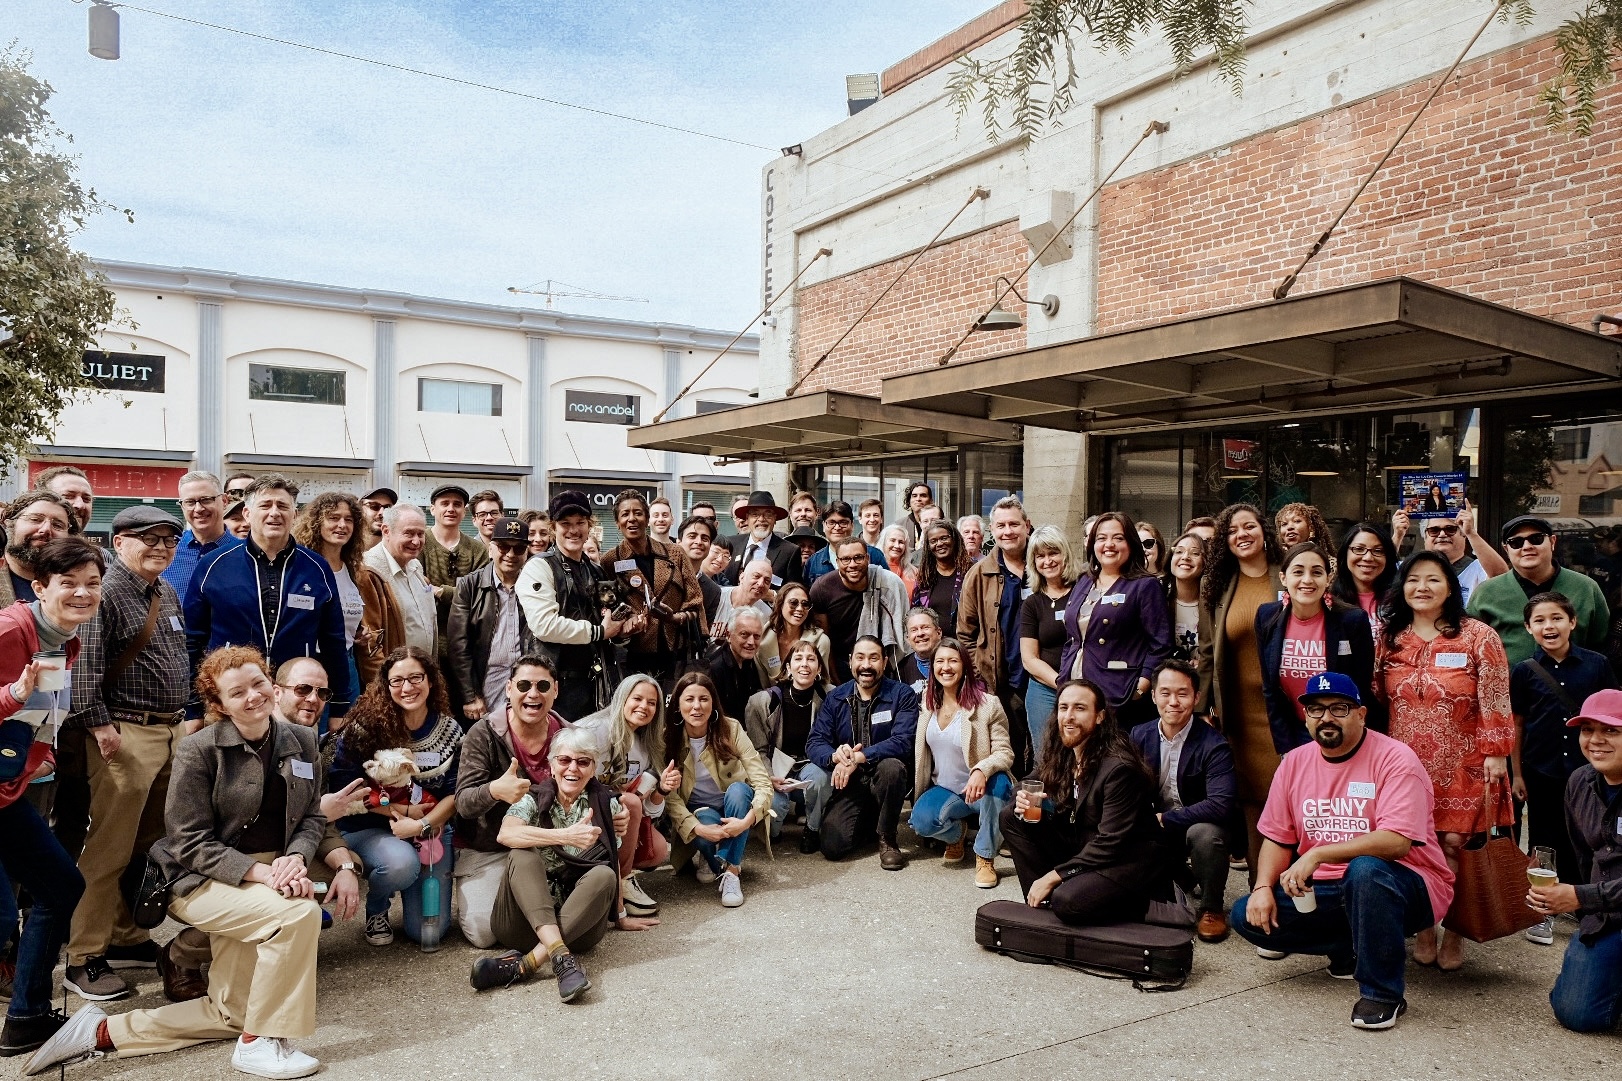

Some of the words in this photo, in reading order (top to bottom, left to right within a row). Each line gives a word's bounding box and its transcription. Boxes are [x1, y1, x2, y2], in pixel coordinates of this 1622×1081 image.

[765, 168, 775, 317] COFFEE
[79, 362, 153, 381] ULIET
[569, 403, 593, 414] nox
[594, 404, 635, 417] anabel
[92, 470, 167, 491] LIET
[1281, 639, 1326, 656] ENN
[1282, 657, 1327, 668] ERRER
[1318, 676, 1331, 690] LA
[1302, 797, 1368, 817] GENNY
